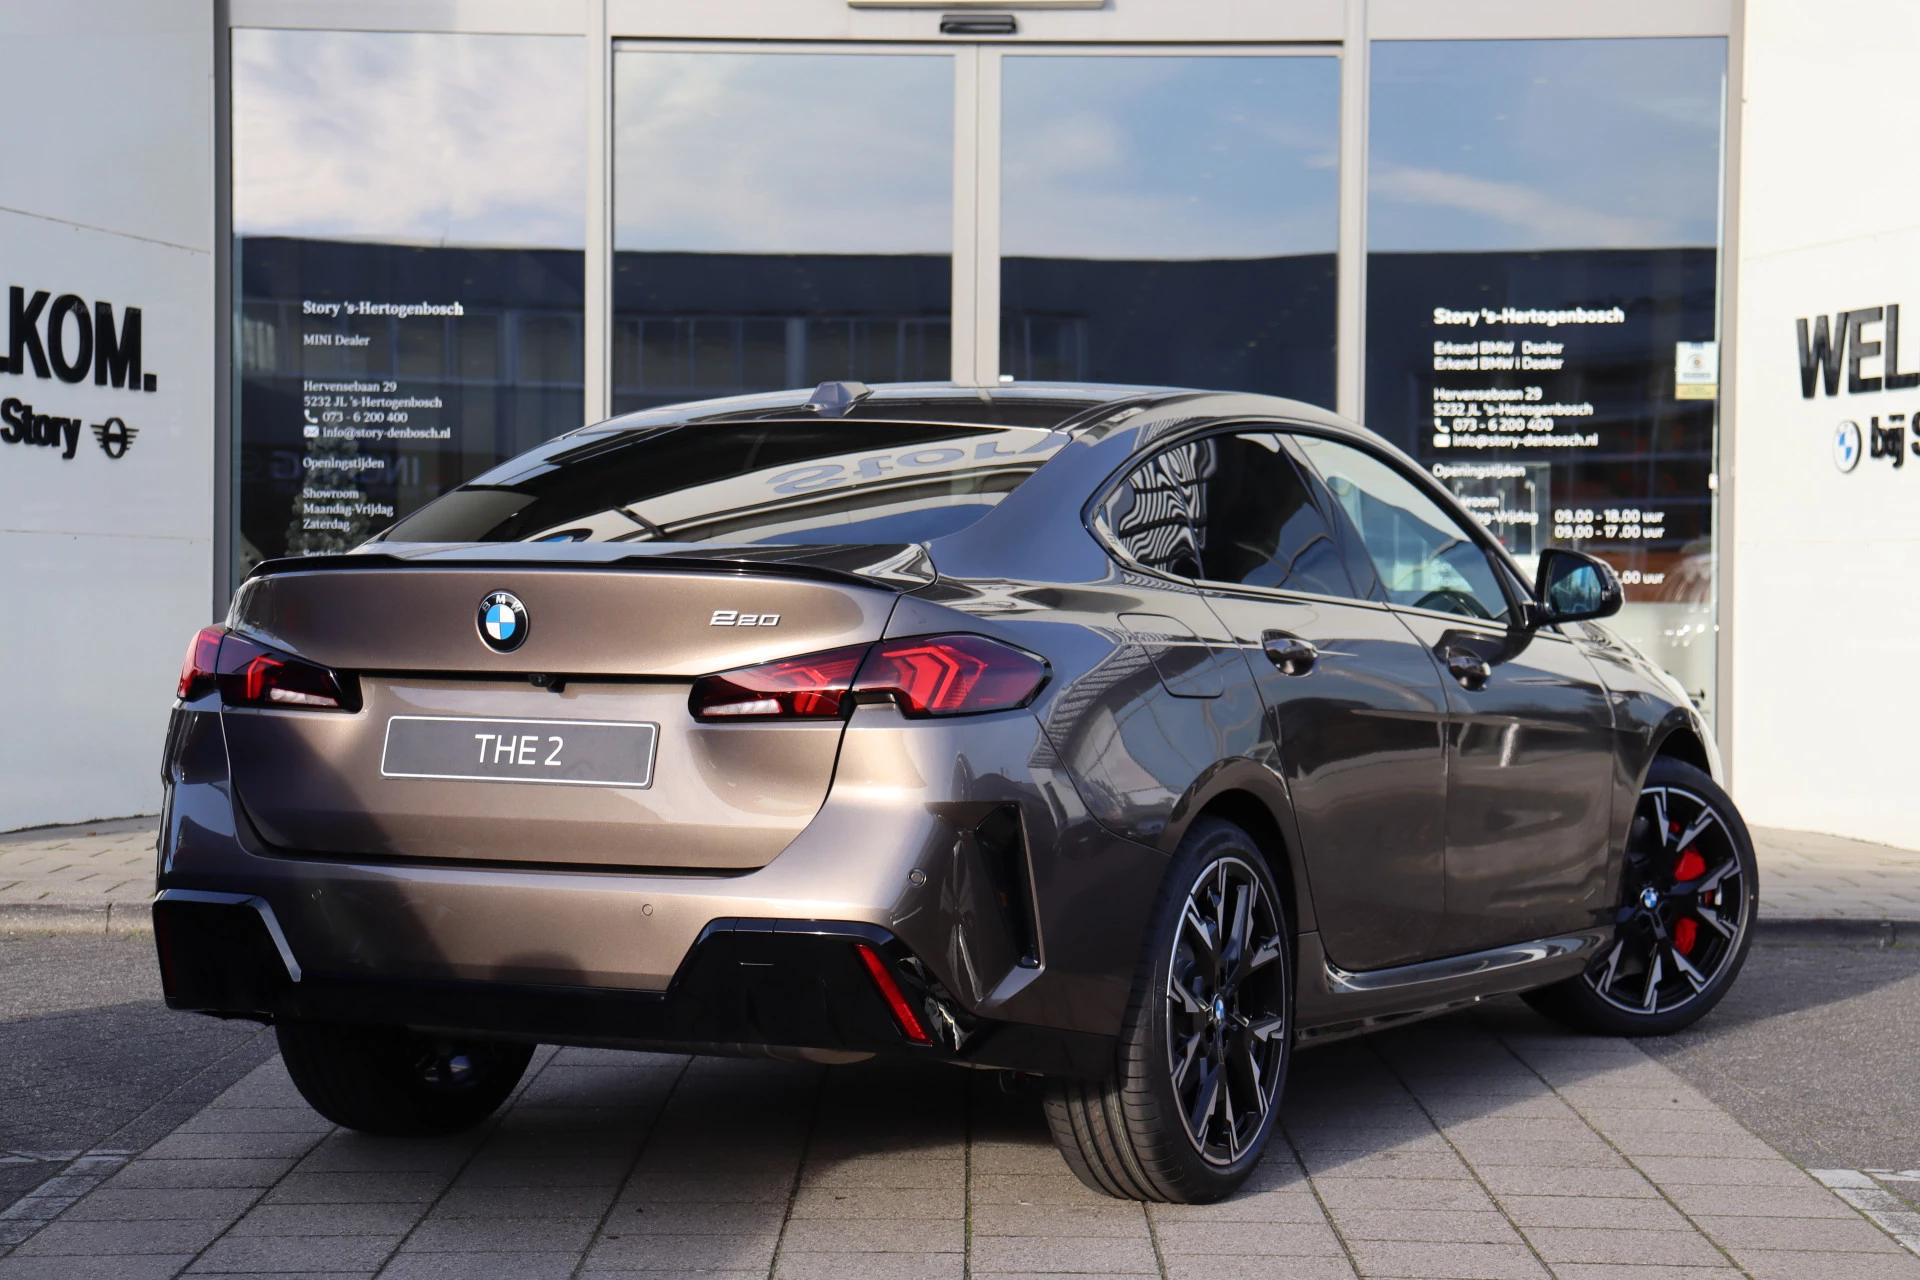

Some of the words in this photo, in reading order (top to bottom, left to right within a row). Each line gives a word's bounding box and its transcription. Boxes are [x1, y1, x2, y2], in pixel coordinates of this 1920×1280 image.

[303, 301, 340, 317] Story
[1433, 307, 1480, 327] Story
[303, 334, 332, 346] MINI
[335, 334, 371, 346] Dealer
[1433, 341, 1478, 355] Erkend
[1480, 341, 1514, 355] BMW
[1522, 341, 1565, 355] Dealer
[1796, 304, 1920, 399] WEL
[1433, 356, 1478, 370] Erkend
[1480, 356, 1514, 370] BMW
[1522, 356, 1565, 370] Dealer
[303, 380, 380, 392] Hervensebaan
[382, 381, 398, 392] 29
[1433, 387, 1524, 401] Hervensebaan
[1525, 386, 1543, 400] 29
[303, 396, 332, 407] 5232
[333, 396, 348, 407] JL
[1433, 402, 1466, 416] 5232
[1467, 403, 1482, 417] JL
[322, 411, 343, 423] 073
[353, 412, 361, 423] 6
[363, 412, 385, 423] 200
[386, 412, 409, 423] 400
[1453, 418, 1478, 431] 073
[1488, 418, 1498, 431] 6
[1499, 418, 1526, 431] 200
[1526, 417, 1554, 431] 400
[1, 398, 82, 460] Story
[323, 426, 451, 440] info@story-denbosch.nl
[1453, 433, 1599, 449] info@story-denbosch.nl
[303, 456, 385, 471] Openingstijden
[1433, 463, 1526, 478] Openingstijden
[303, 488, 359, 499] Showroom
[303, 503, 394, 517] Maandag-Vrijdag
[1554, 509, 1594, 523] 09.00
[1642, 512, 1665, 523] uur
[303, 519, 351, 532] Zaterdag
[1554, 524, 1594, 538] 09.00
[1643, 527, 1665, 538] uur
[1643, 573, 1665, 584] uur
[481, 594, 523, 613] BMW
[709, 610, 781, 627] 220
[474, 733, 539, 765] THE
[544, 736, 564, 766] 2
